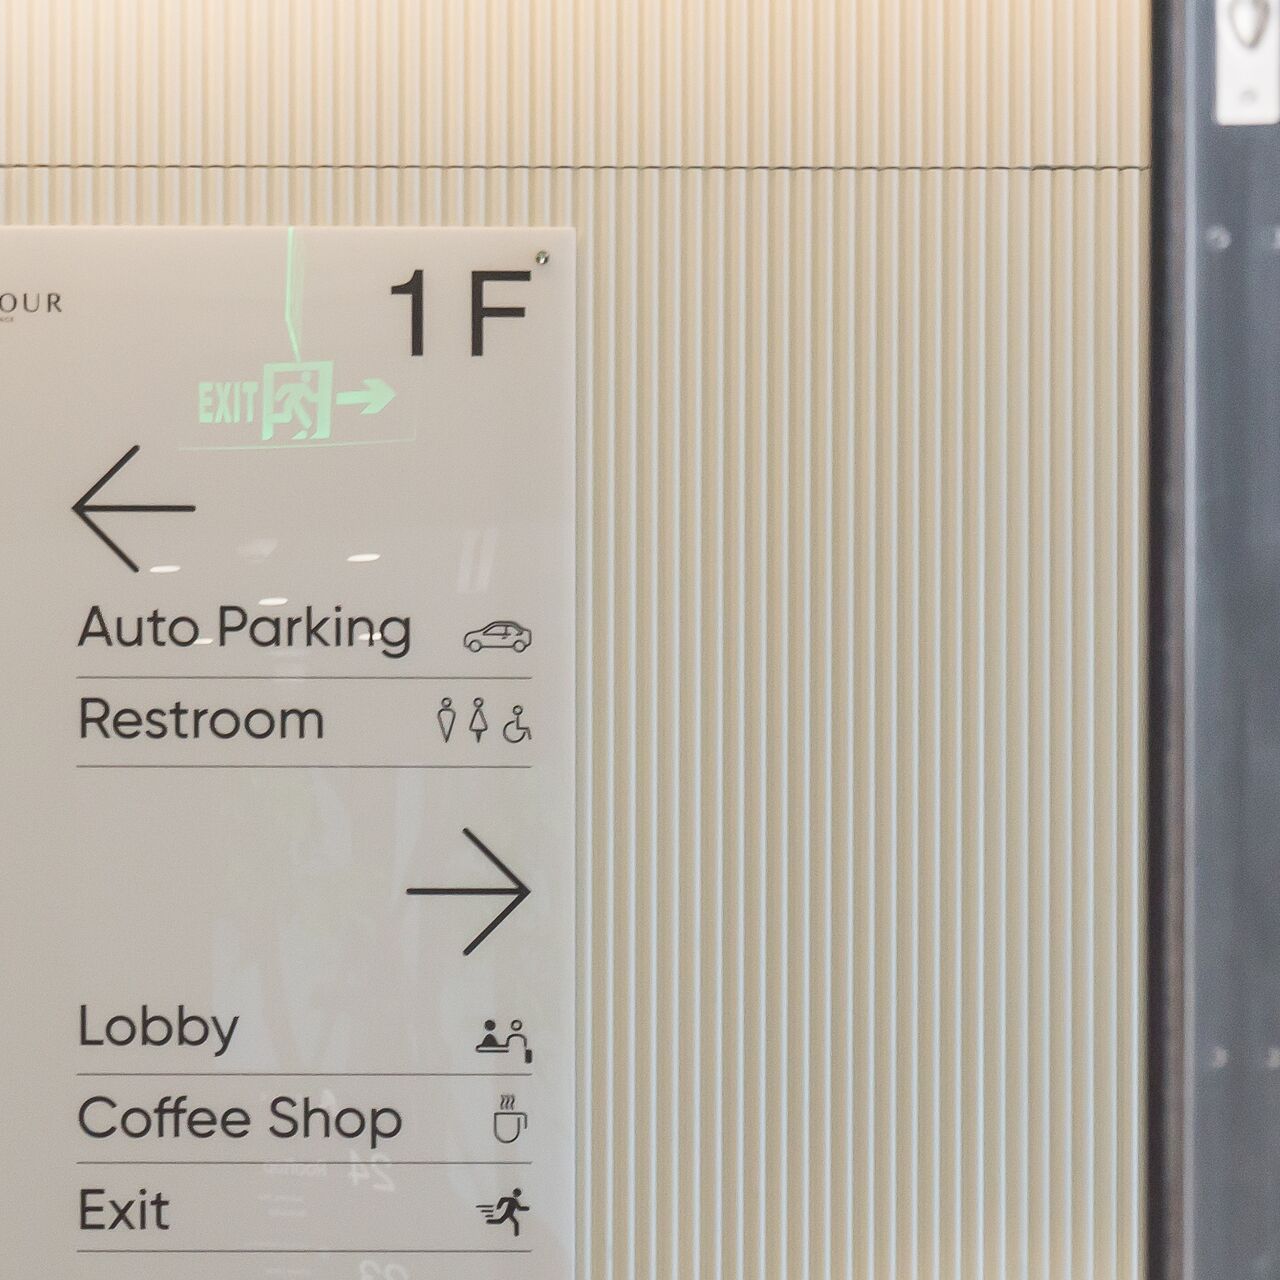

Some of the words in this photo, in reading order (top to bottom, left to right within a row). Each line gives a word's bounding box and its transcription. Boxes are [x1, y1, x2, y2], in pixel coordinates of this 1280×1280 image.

[198, 381, 258, 424] EXIT
[78, 605, 199, 648] Auto
[219, 605, 410, 659] Parking
[80, 697, 323, 739] Restroom
[80, 1004, 239, 1057] Lobby
[78, 1095, 251, 1139] Coffee
[269, 1096, 402, 1149] Shop
[80, 1188, 170, 1231] Exit
